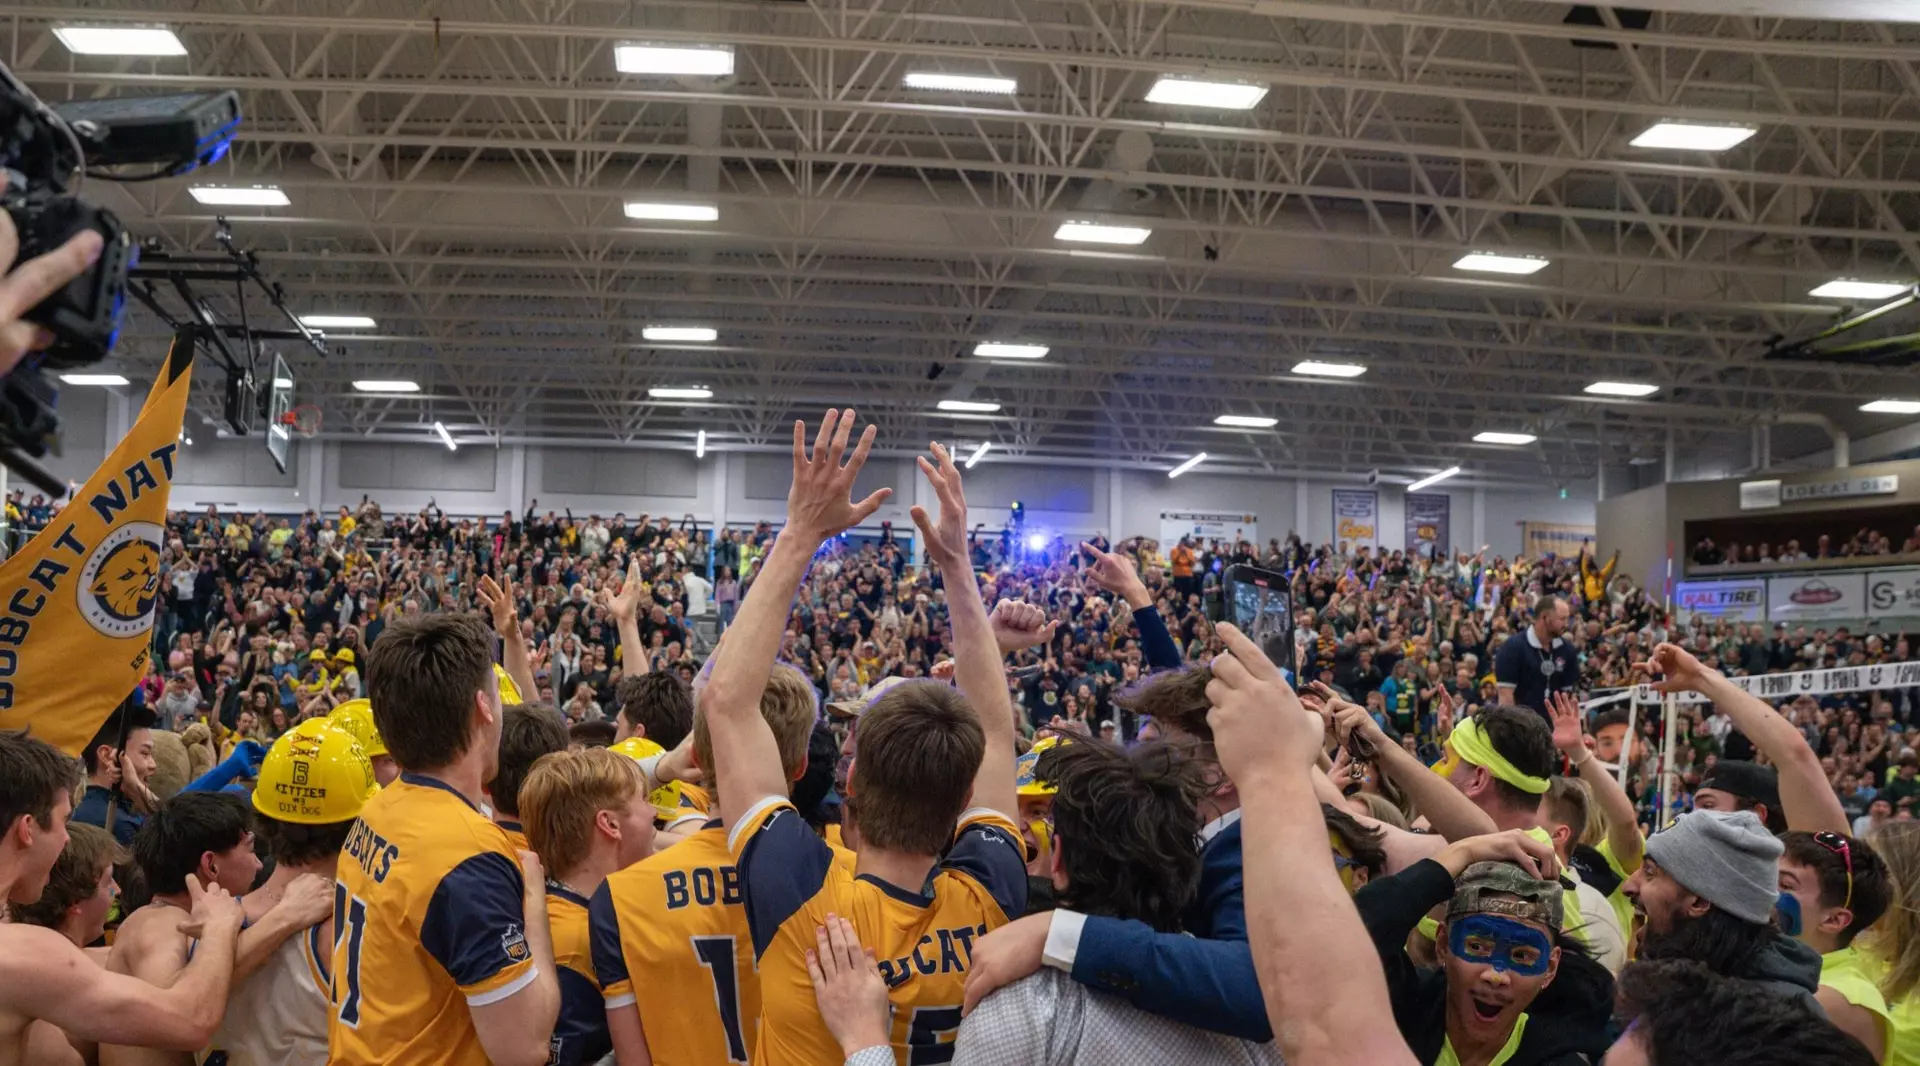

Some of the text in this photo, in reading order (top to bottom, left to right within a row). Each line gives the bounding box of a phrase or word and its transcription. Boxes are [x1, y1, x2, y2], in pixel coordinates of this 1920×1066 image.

[1684, 590, 1758, 605] KAL TIRE
[275, 782, 327, 799] KITTIES
[278, 802, 298, 814] DIX
[663, 865, 744, 910] BOB
